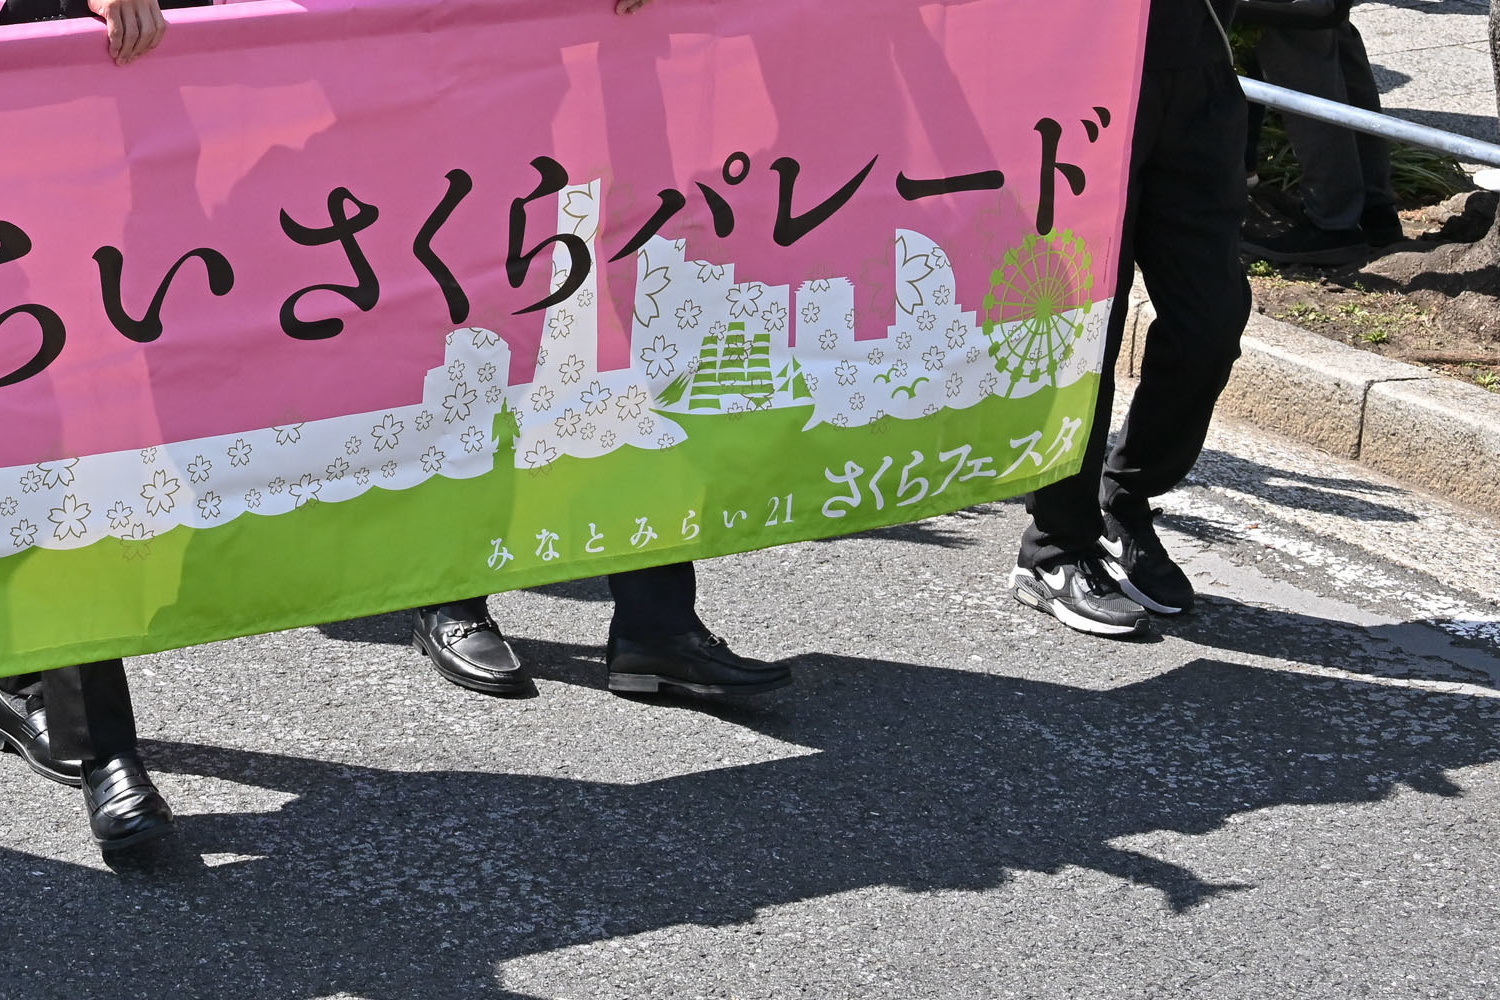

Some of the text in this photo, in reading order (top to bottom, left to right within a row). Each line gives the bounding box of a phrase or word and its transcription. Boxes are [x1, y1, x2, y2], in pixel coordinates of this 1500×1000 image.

[821, 415, 1082, 519] さくらフェスタ
